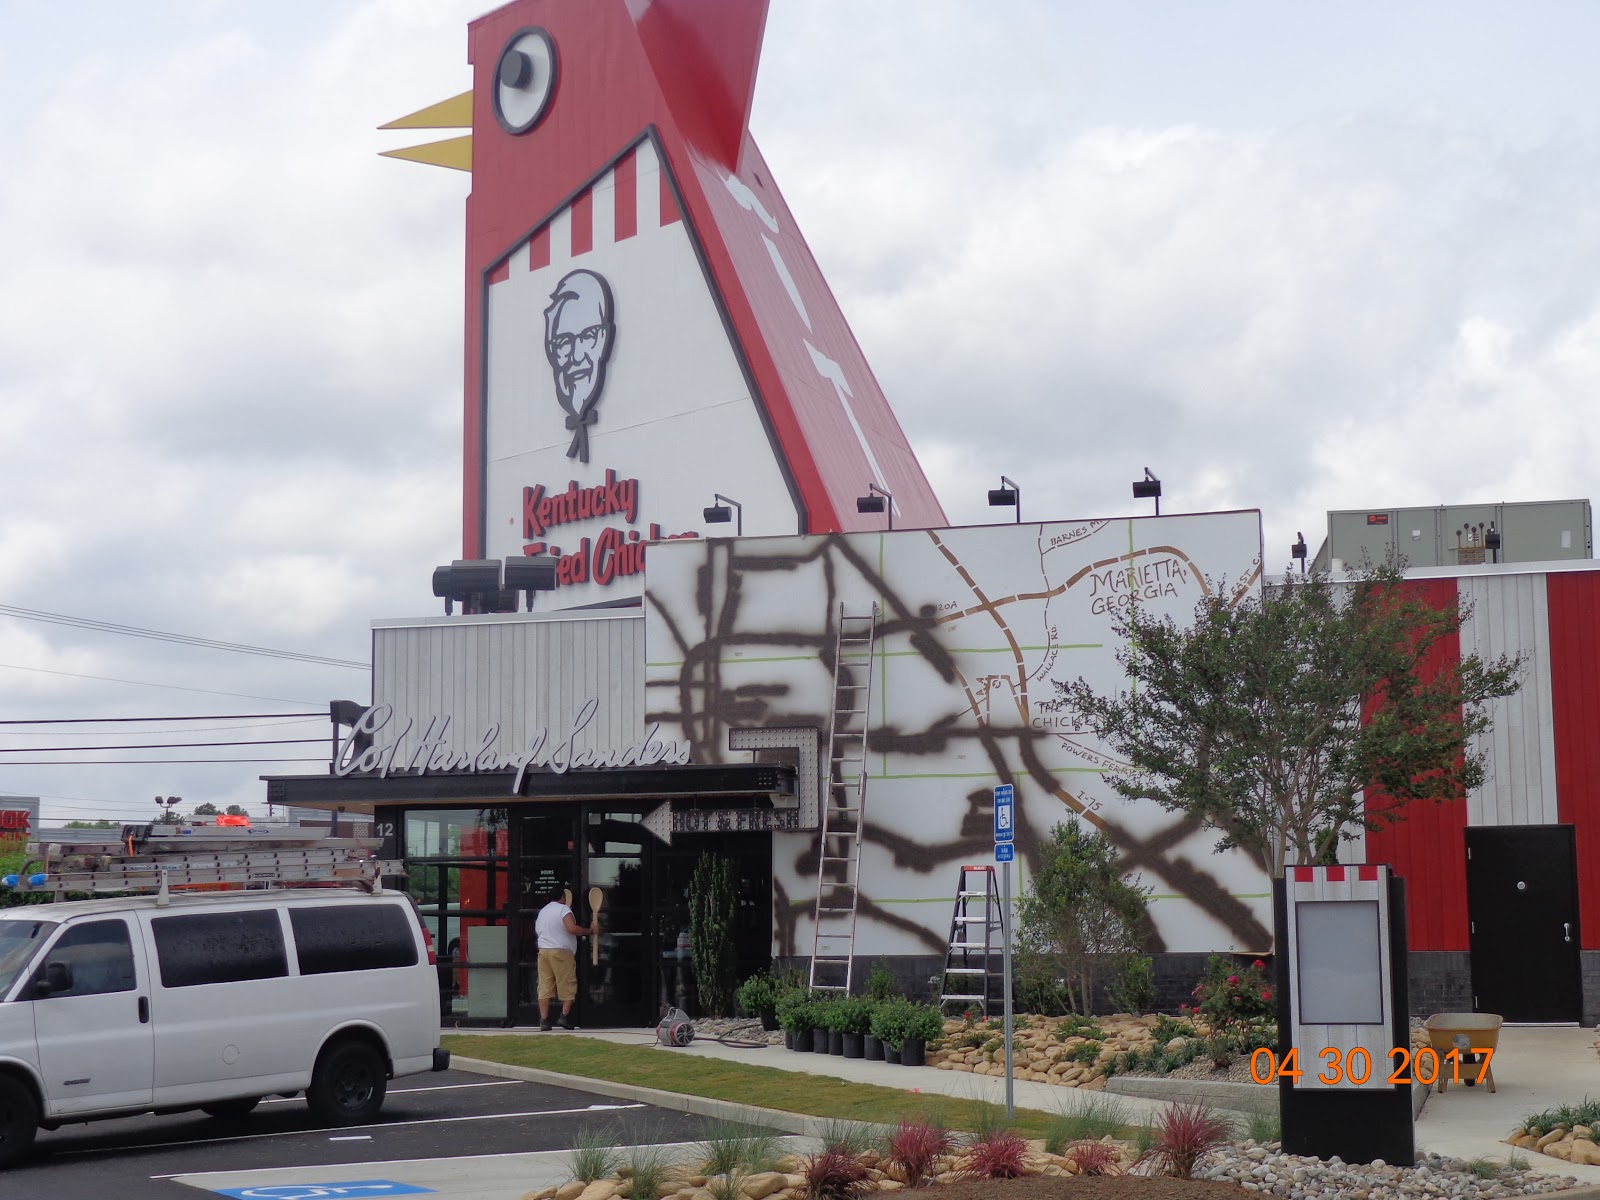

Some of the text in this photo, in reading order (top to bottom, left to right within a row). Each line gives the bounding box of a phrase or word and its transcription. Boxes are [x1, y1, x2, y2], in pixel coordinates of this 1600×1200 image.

[523, 468, 638, 539] Kentucky
[1050, 526, 1087, 546] BARNES
[592, 523, 699, 586] Chic
[1089, 559, 1187, 597] MARIETTA,
[1231, 568, 1251, 596] EAST
[1091, 582, 1179, 615] GEORGIA
[1037, 643, 1059, 682] WALLACE
[538, 696, 692, 775] Sanders
[1061, 742, 1099, 764] POWERS
[1077, 790, 1103, 811] I-75
[0, 810, 31, 828] OK
[376, 822, 393, 837] 12
[672, 808, 799, 832] HOT & FRESH
